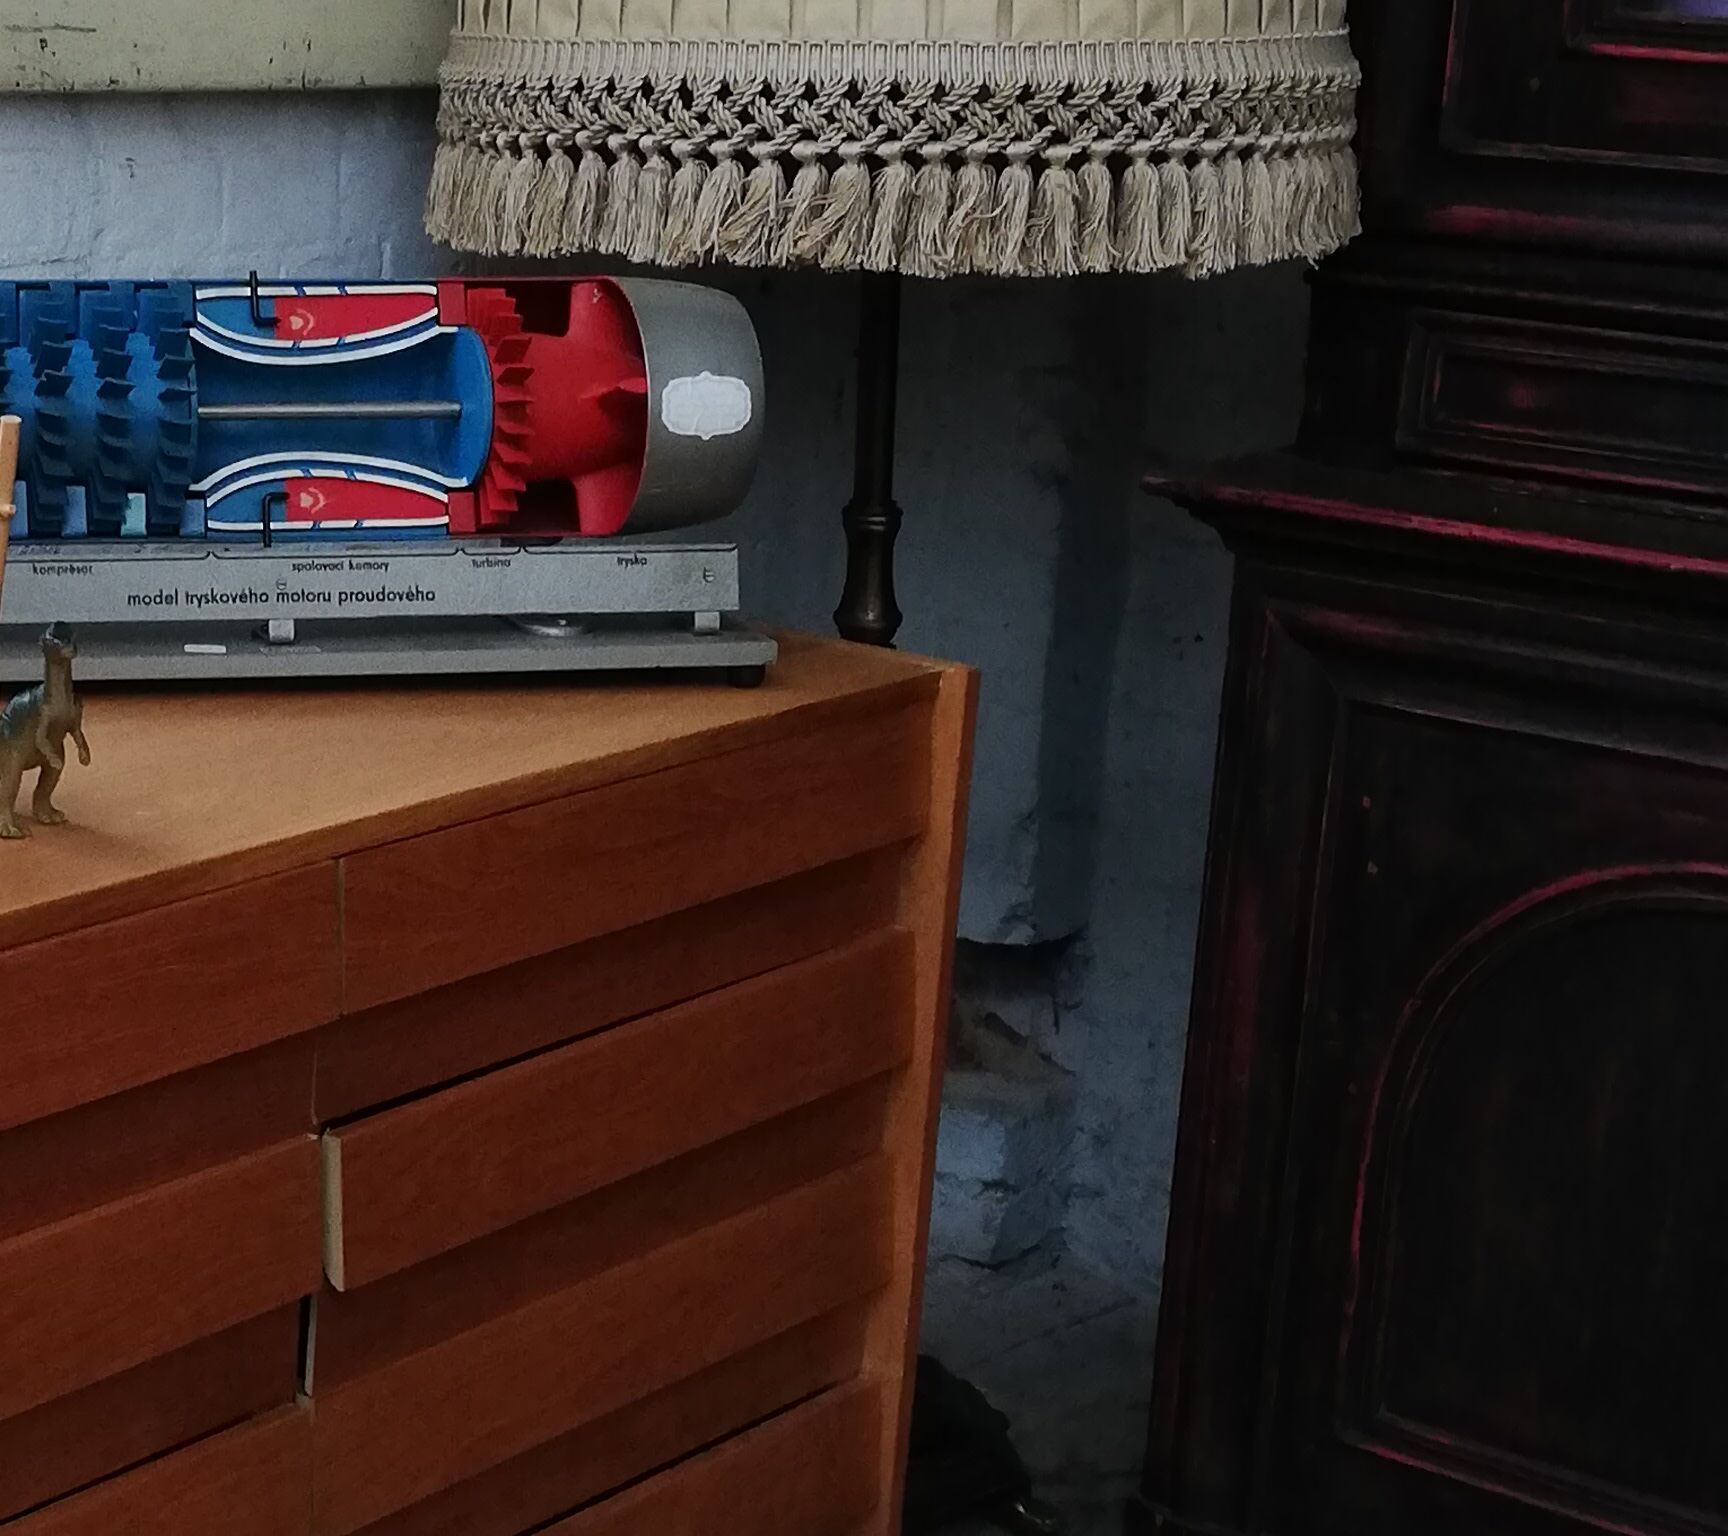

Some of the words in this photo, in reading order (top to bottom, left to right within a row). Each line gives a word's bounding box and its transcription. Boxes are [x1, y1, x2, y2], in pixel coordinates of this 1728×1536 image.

[127, 588, 179, 606] model
[184, 587, 269, 609] tryskového
[276, 588, 332, 604] motoru
[338, 584, 436, 606] proudového
